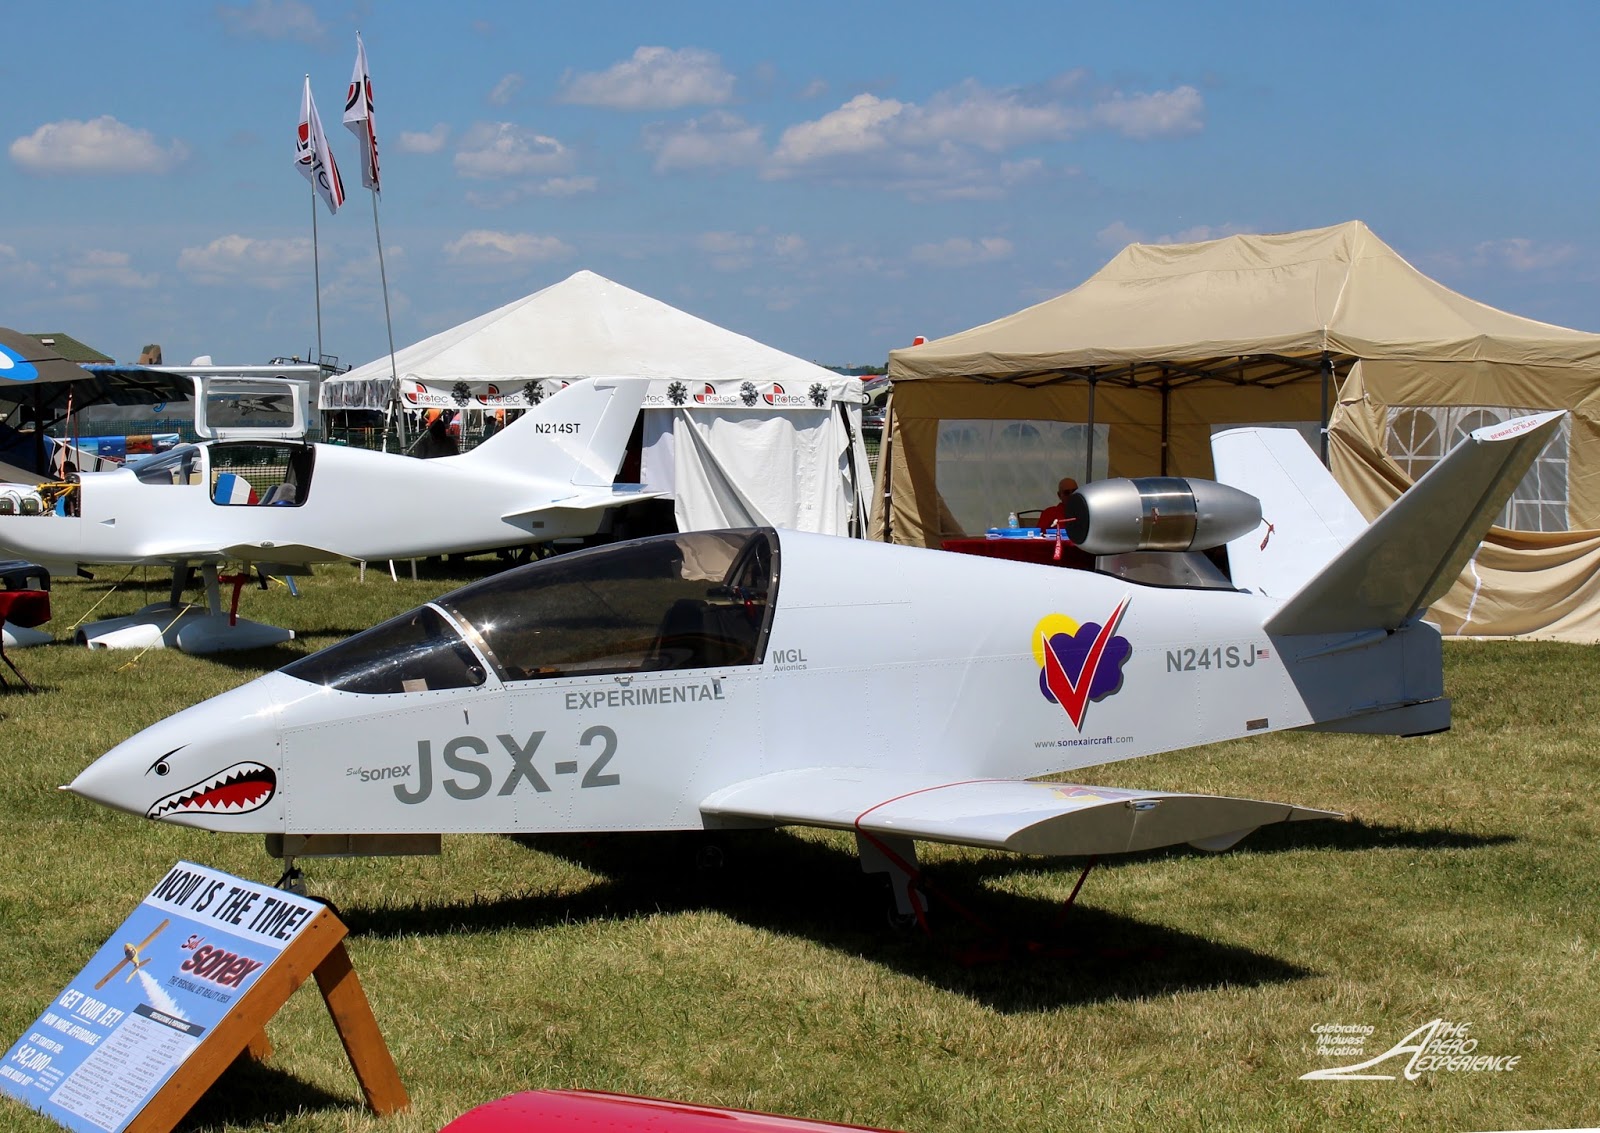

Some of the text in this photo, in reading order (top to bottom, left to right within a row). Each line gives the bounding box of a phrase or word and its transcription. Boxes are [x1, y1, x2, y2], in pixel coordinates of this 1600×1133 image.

[418, 393, 448, 403] Rotec
[488, 394, 520, 403] Rotec
[643, 395, 665, 403] tec
[705, 394, 737, 403] Rotec
[774, 394, 806, 403] Rotec
[535, 423, 581, 434] N214ST
[1490, 429, 1513, 440] BEWARE
[772, 649, 808, 664] MGL
[1166, 644, 1256, 673] N241SJ
[773, 663, 807, 672] Avionics
[565, 683, 725, 710] EXPERIMENTAL
[1034, 735, 1134, 749] www.sonexaircraft.com
[393, 724, 621, 805] JSX-2
[360, 764, 411, 782] sonex
[152, 868, 313, 941] NOW IS THE TIME!
[180, 944, 264, 989] sonex
[167, 975, 179, 986] THE
[175, 978, 198, 993] PERSONAL
[194, 986, 205, 995] JET
[59, 988, 125, 1028] GET YOUR JET!
[42, 1012, 102, 1046] NOW MORE AFFORDABLE
[11, 1043, 52, 1072] $42,000
